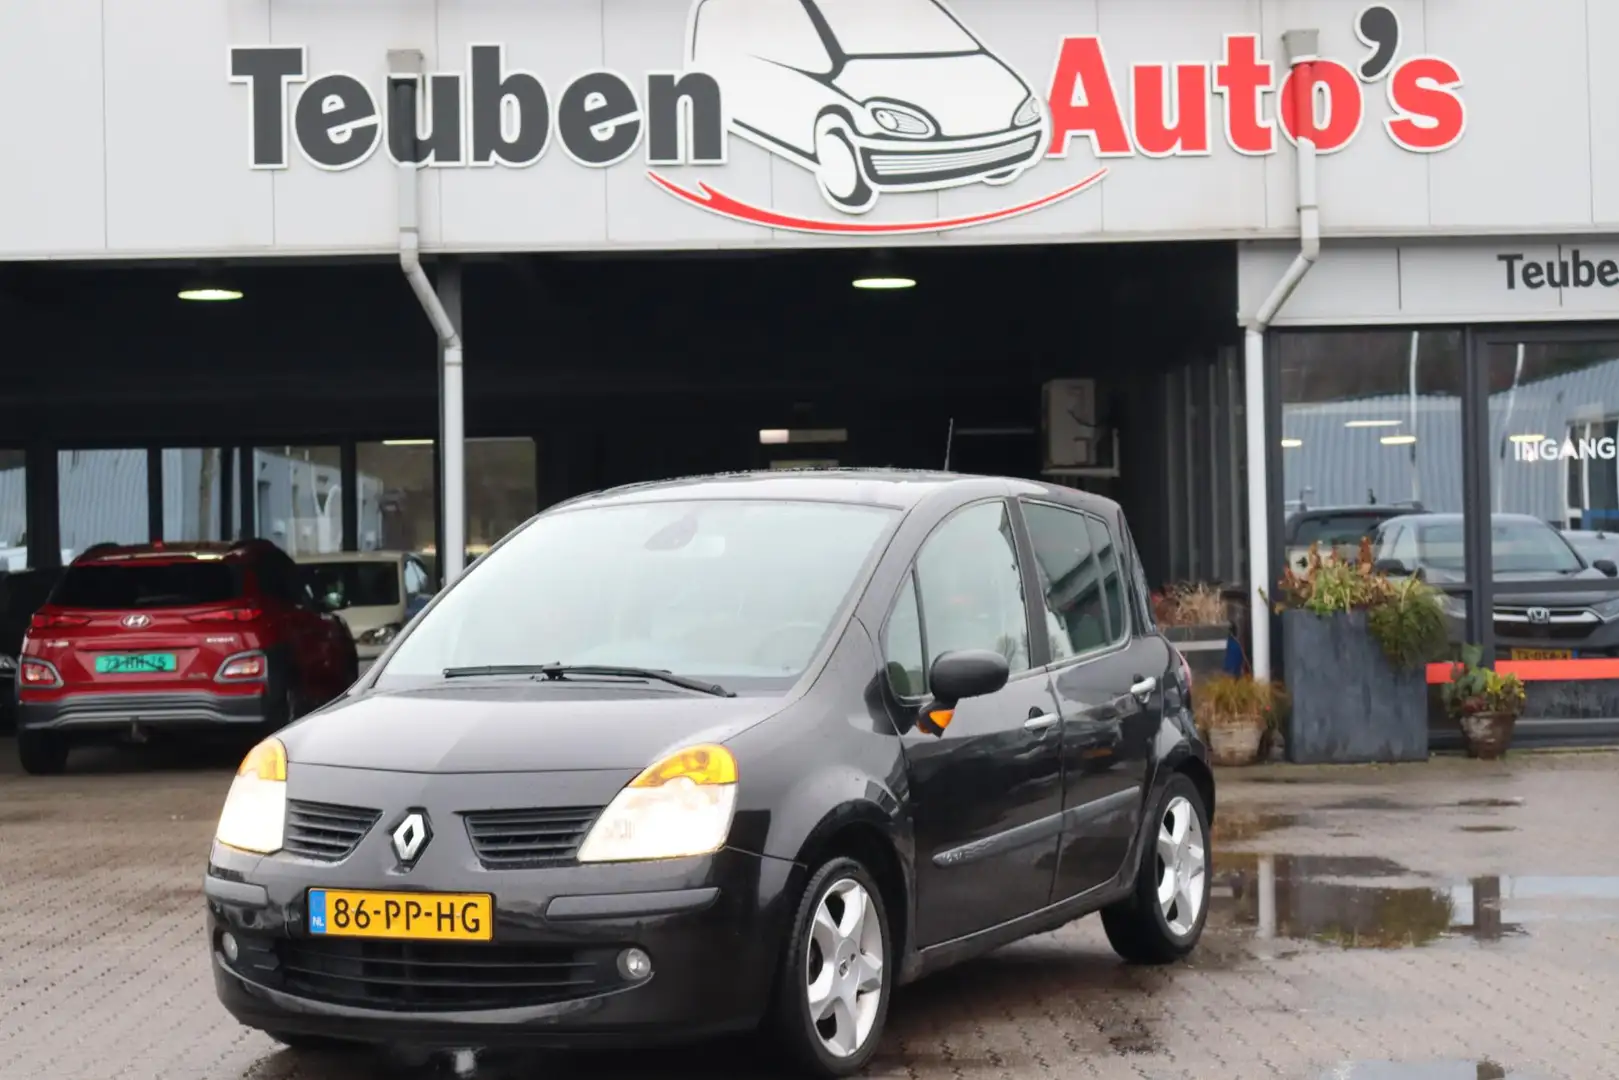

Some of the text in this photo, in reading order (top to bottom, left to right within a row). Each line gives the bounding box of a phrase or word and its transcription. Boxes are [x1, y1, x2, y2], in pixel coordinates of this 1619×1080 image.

[228, 3, 1467, 171] Teuben Auto's
[1514, 437, 1616, 461] INGANG
[312, 898, 480, 933] NL 86-PP-HG
